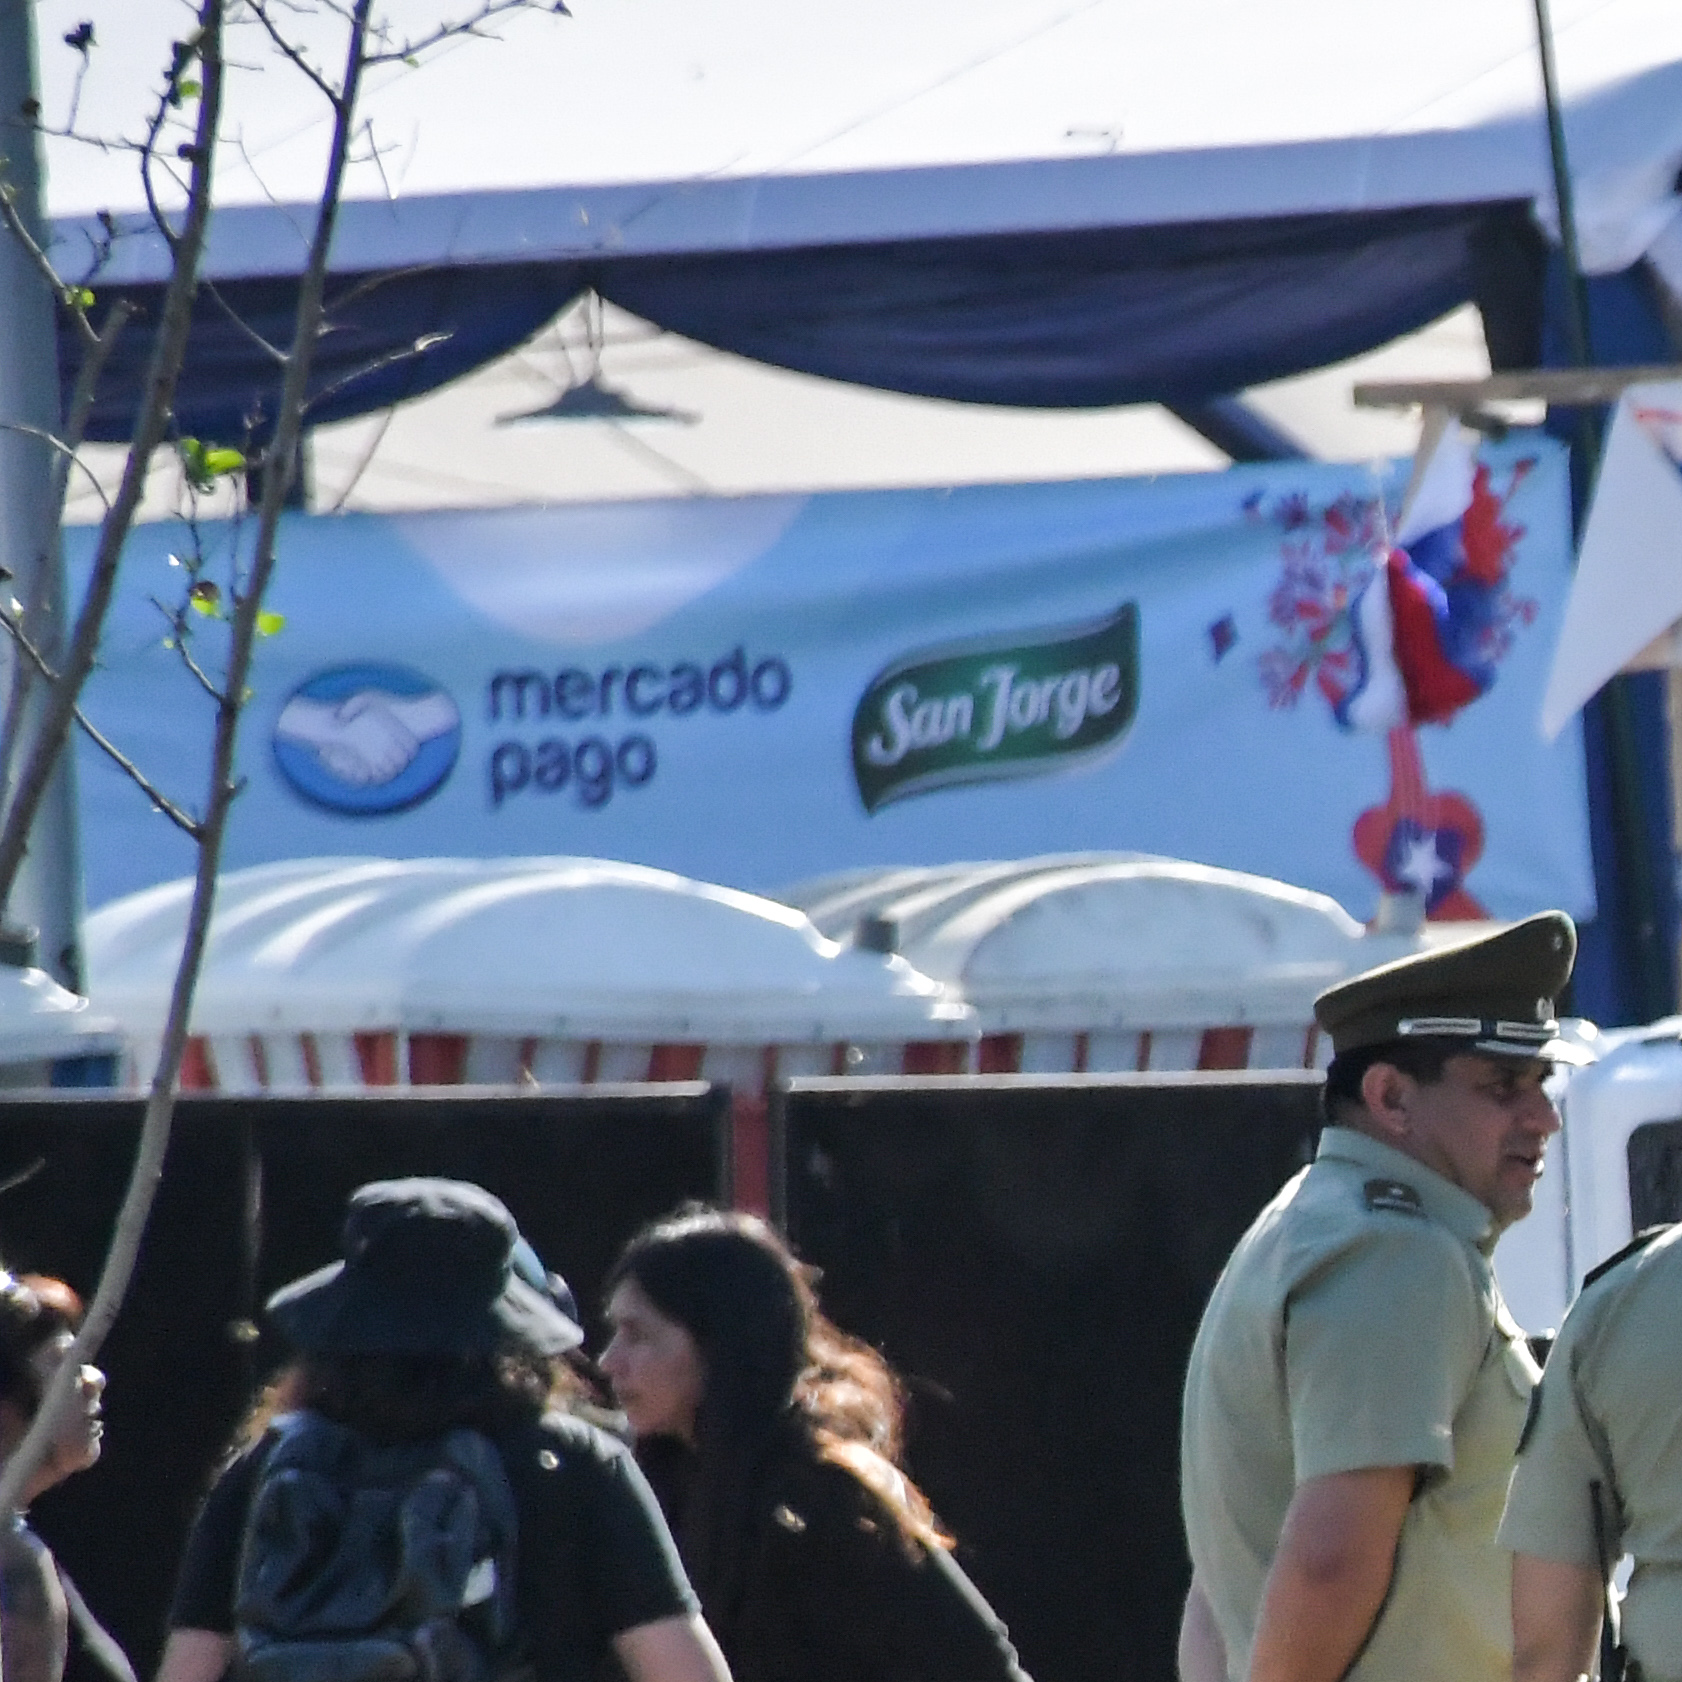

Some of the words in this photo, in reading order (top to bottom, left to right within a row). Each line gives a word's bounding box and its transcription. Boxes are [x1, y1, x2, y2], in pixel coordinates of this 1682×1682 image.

[490, 646, 792, 720] mercado
[868, 683, 974, 766] San
[976, 661, 1121, 750] Jorge
[491, 734, 658, 808] pago
